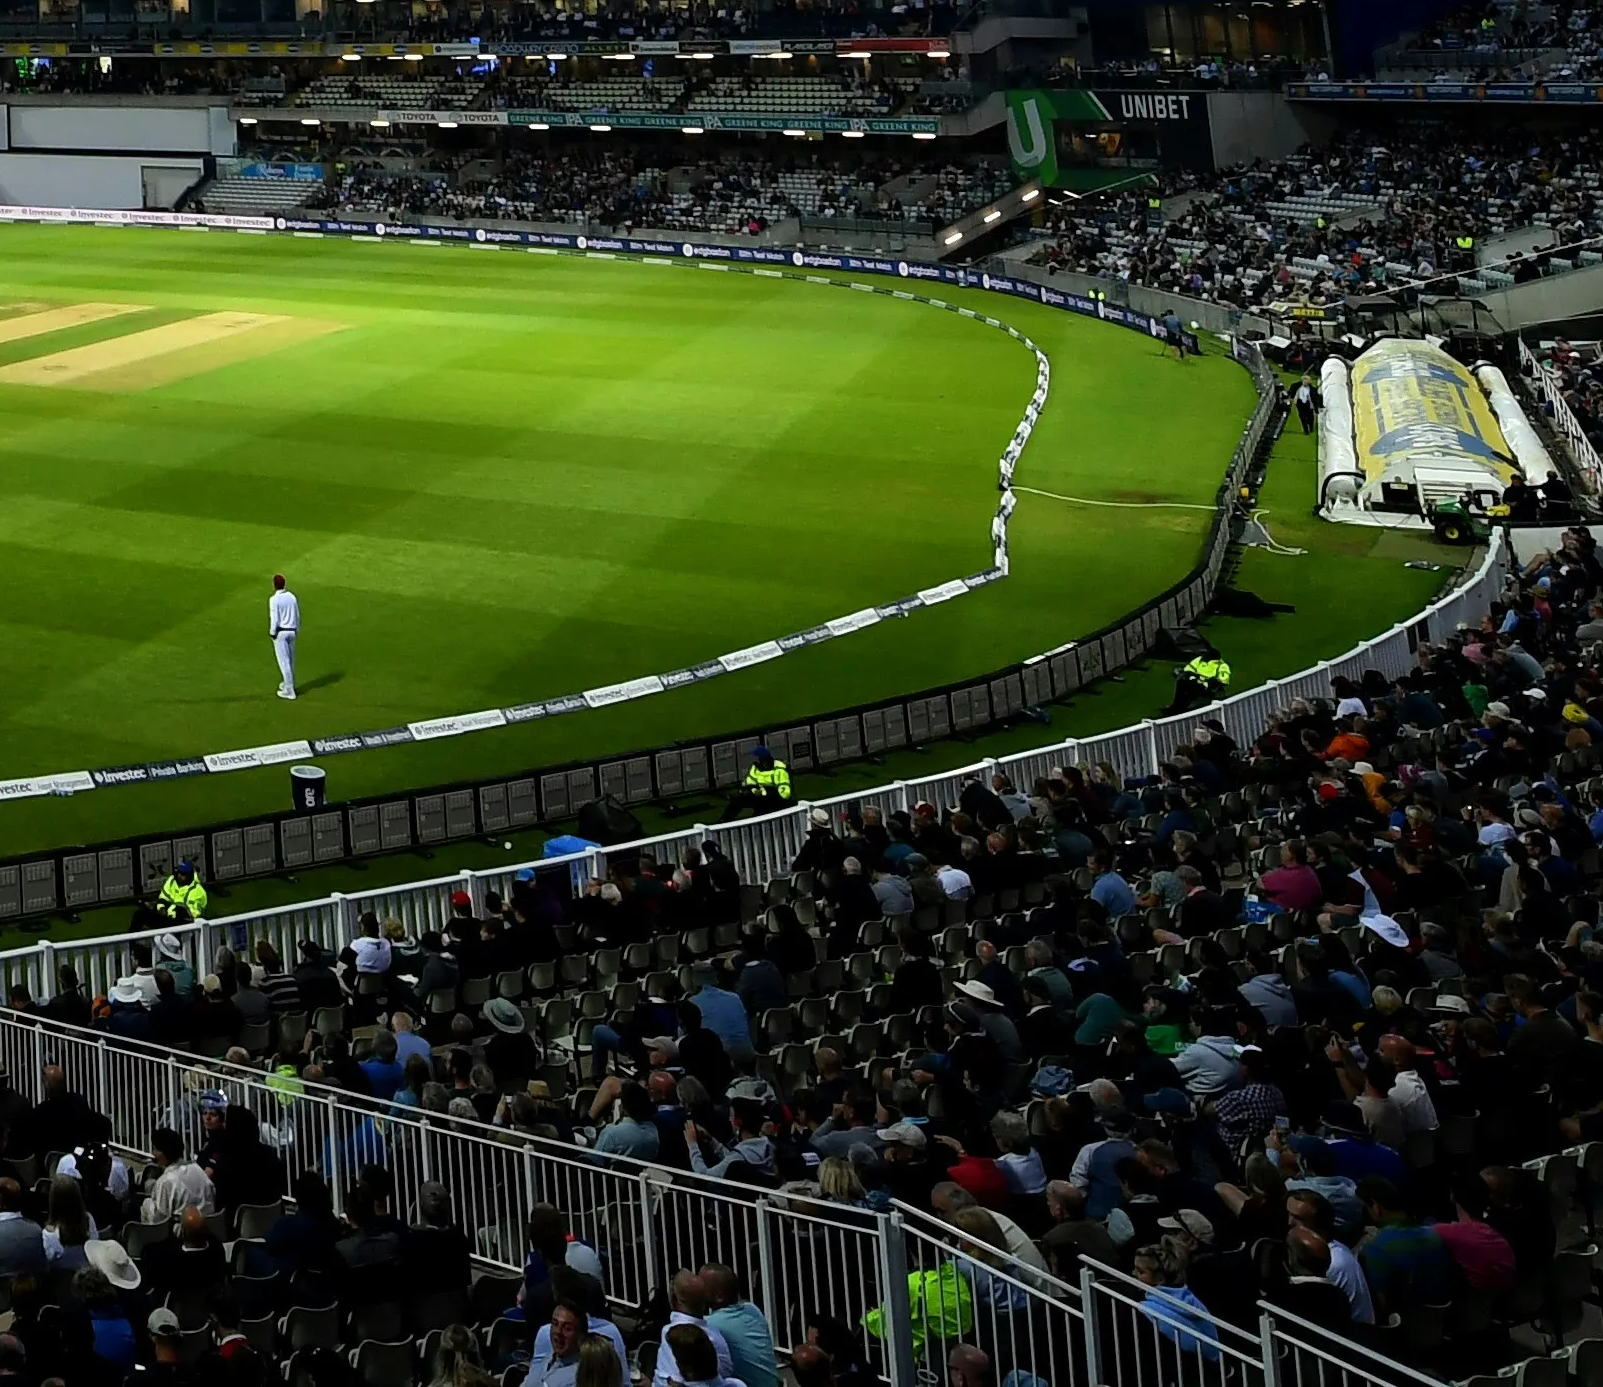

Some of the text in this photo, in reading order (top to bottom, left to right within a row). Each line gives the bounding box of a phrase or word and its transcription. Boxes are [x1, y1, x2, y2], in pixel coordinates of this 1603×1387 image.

[1121, 95, 1190, 119] UNIBET
[401, 113, 437, 121] TOYOTA
[464, 114, 499, 122] TOYOTA
[585, 116, 641, 125] GREENE KING
[645, 117, 701, 125] GREENE KING
[725, 119, 783, 128] GREENE KING
[787, 119, 847, 130] GREENE KING
[872, 123, 935, 131] GREENE KING
[1008, 99, 1046, 167] U
[78, 211, 113, 220] Investec
[129, 214, 164, 222] Investec
[181, 216, 217, 224] Investec
[233, 218, 270, 226] Investec
[324, 736, 361, 751] Investec
